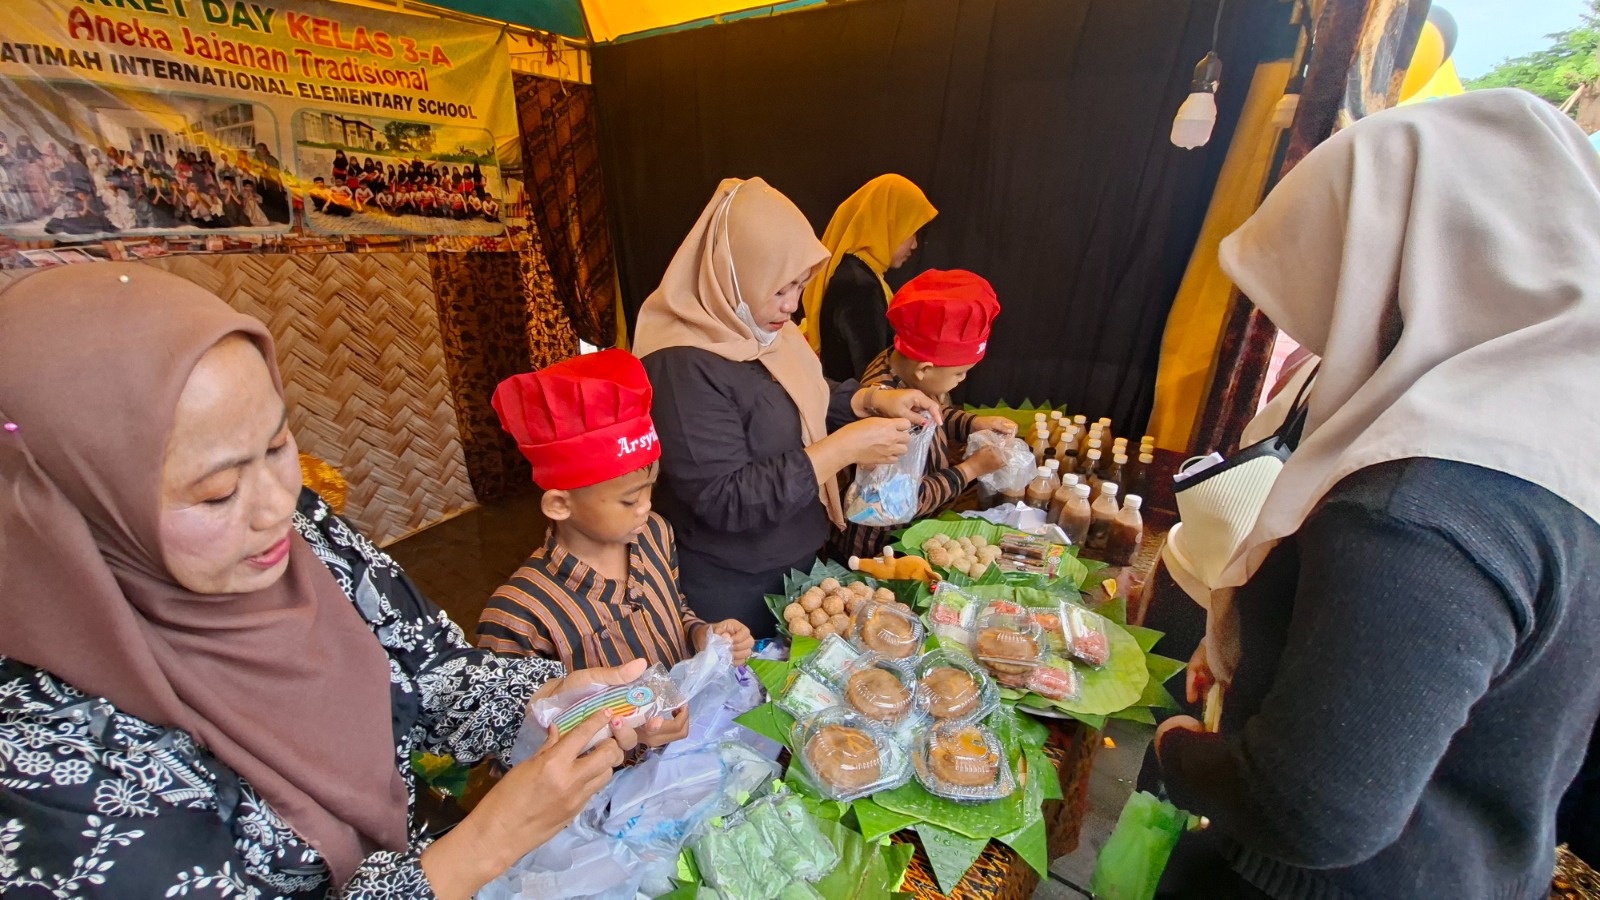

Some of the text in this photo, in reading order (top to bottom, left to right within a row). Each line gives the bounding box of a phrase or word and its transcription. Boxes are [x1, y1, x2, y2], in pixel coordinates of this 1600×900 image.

[67, 6, 429, 92] Aneka Jajanan Tradisional
[204, 0, 275, 33] DAY
[286, 12, 394, 58] KELAS
[400, 37, 453, 68] 3-A
[109, 53, 293, 97] INTERNATIONAL
[297, 82, 413, 112] ELEMENTARY
[417, 98, 477, 120] SCHOOL
